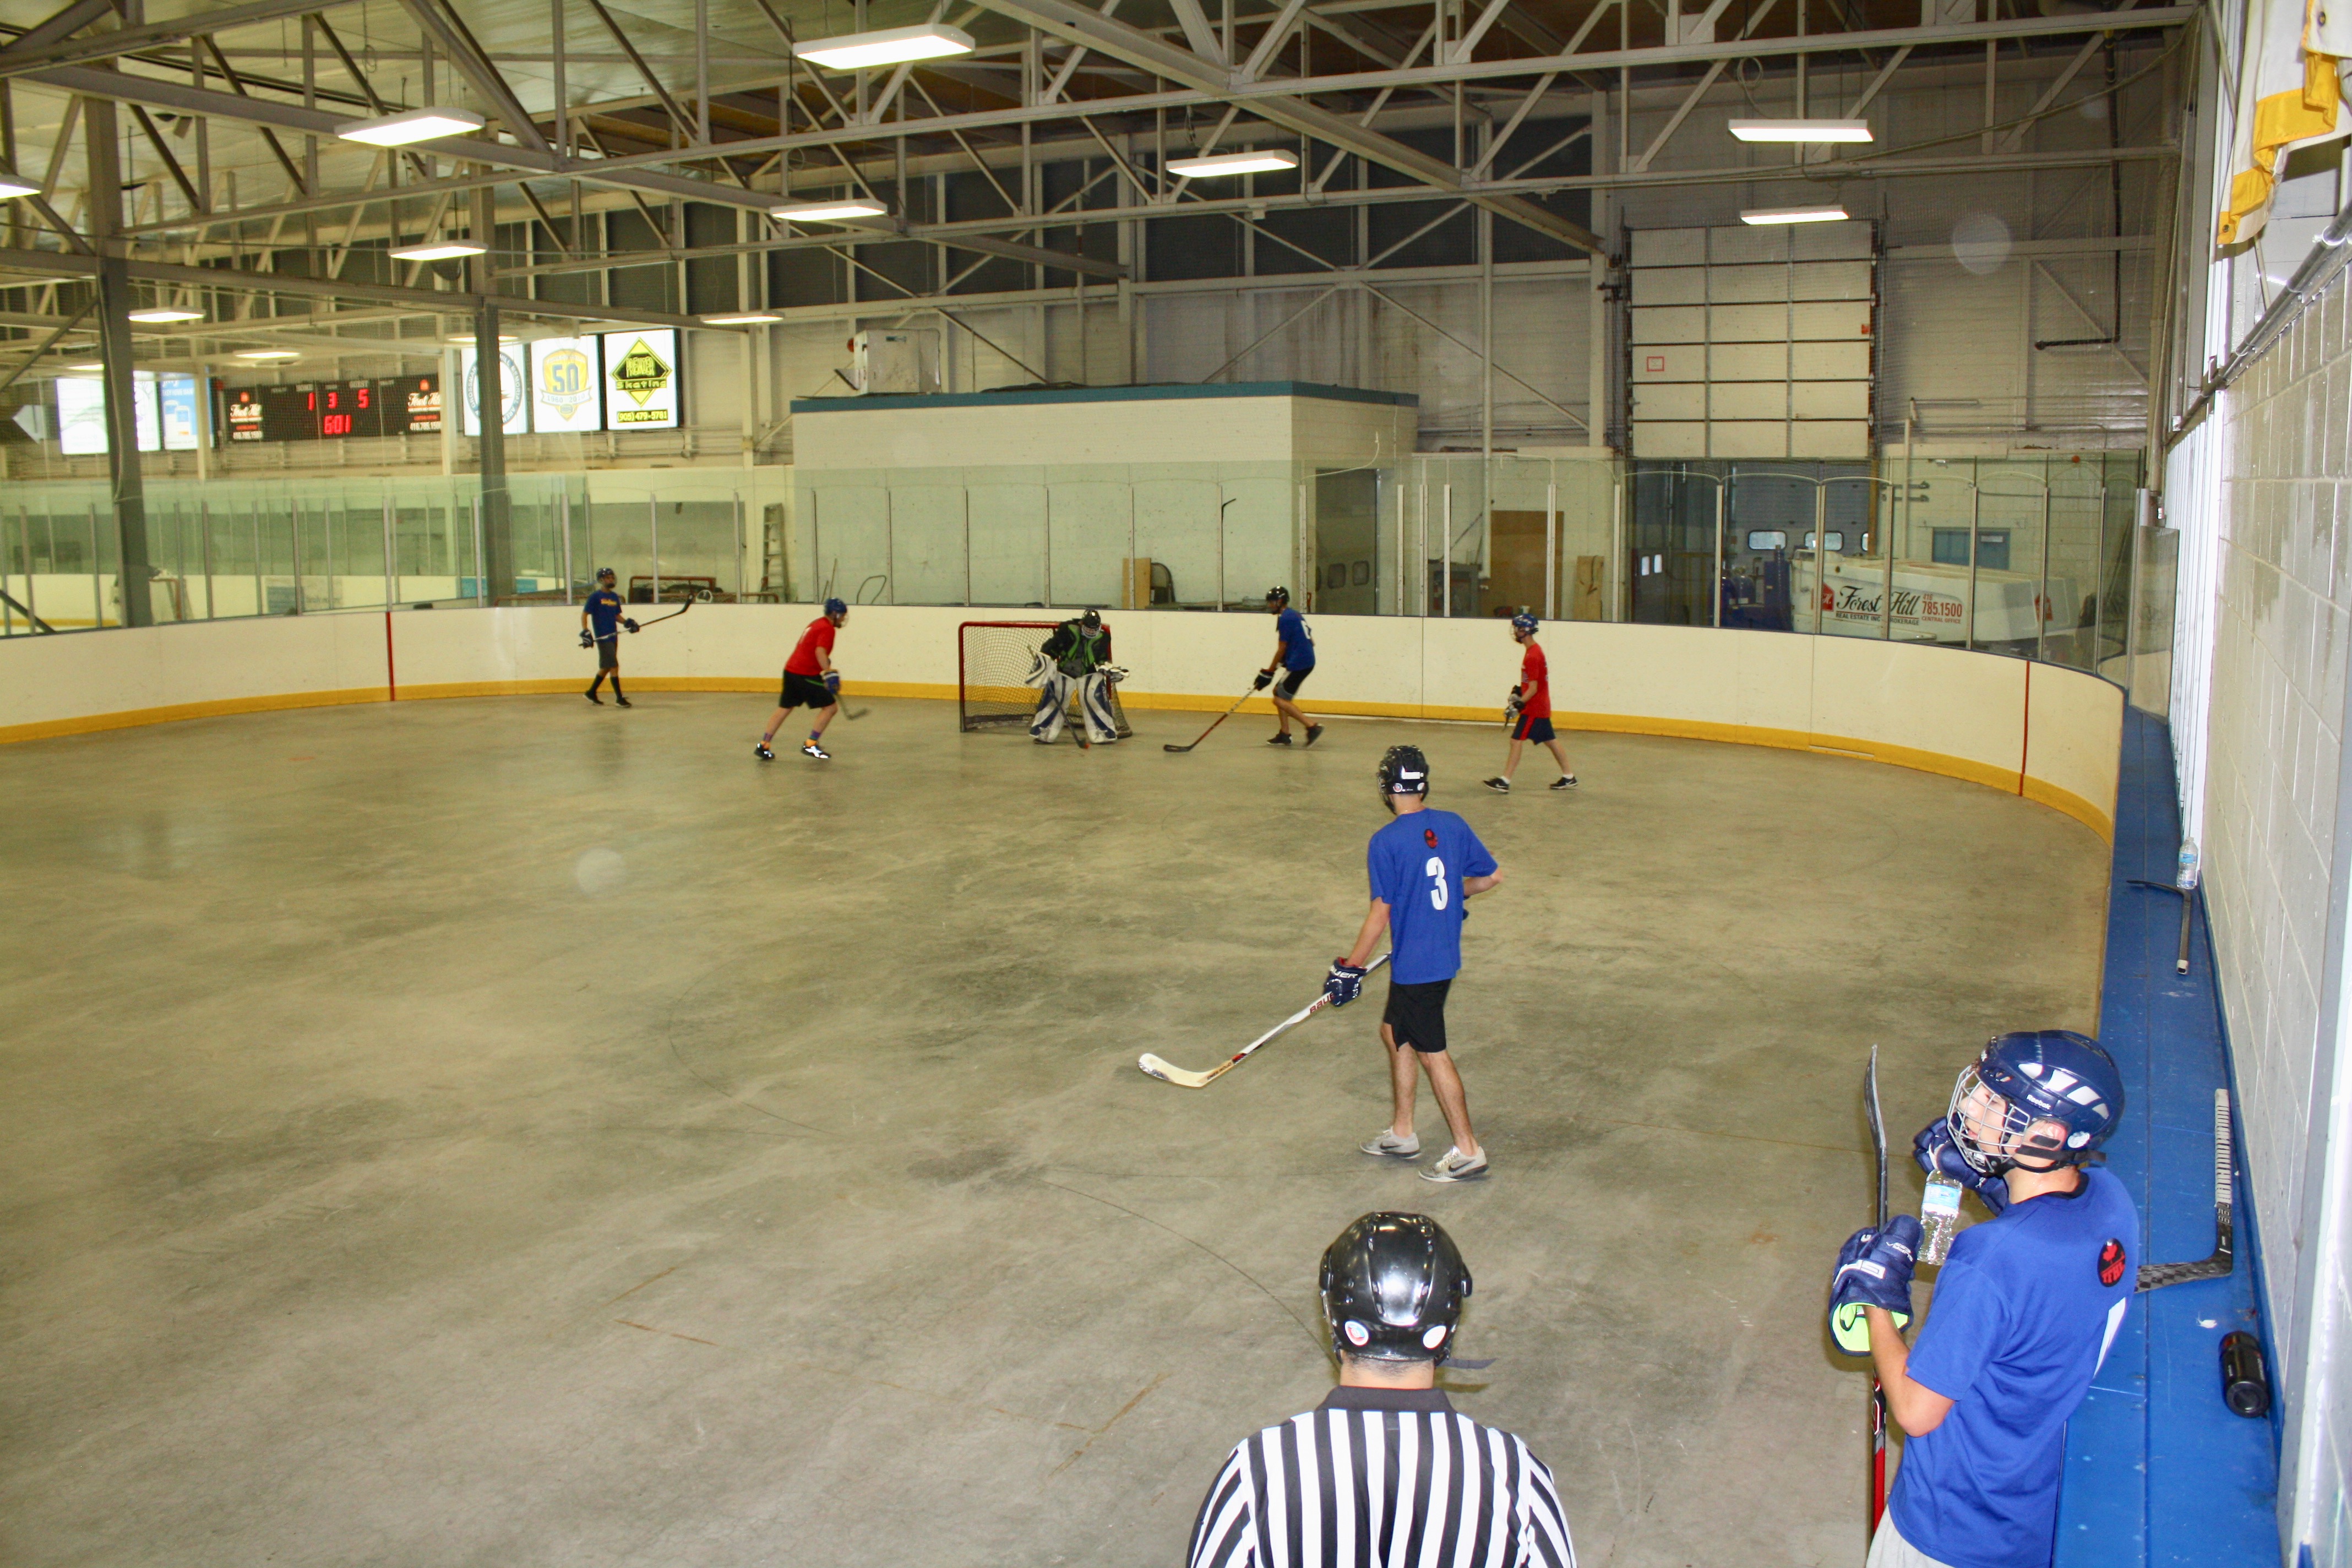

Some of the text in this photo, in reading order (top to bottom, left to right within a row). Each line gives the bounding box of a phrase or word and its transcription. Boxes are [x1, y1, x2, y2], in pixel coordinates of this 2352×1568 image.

[510, 366, 520, 403] MEMORIAL
[552, 363, 579, 393] 50
[617, 380, 666, 389] Skating
[308, 392, 315, 411] 1
[328, 392, 338, 409] 3
[358, 389, 369, 409] 5
[502, 406, 516, 423] AREN
[618, 412, 635, 422] (905)
[1836, 585, 1921, 616] Forest Hill
[1922, 601, 1963, 617] 785.1500
[1890, 617, 1919, 625] ROKERAGE
[1426, 856, 1449, 911] 3
[2026, 1094, 2051, 1110] Reebok
